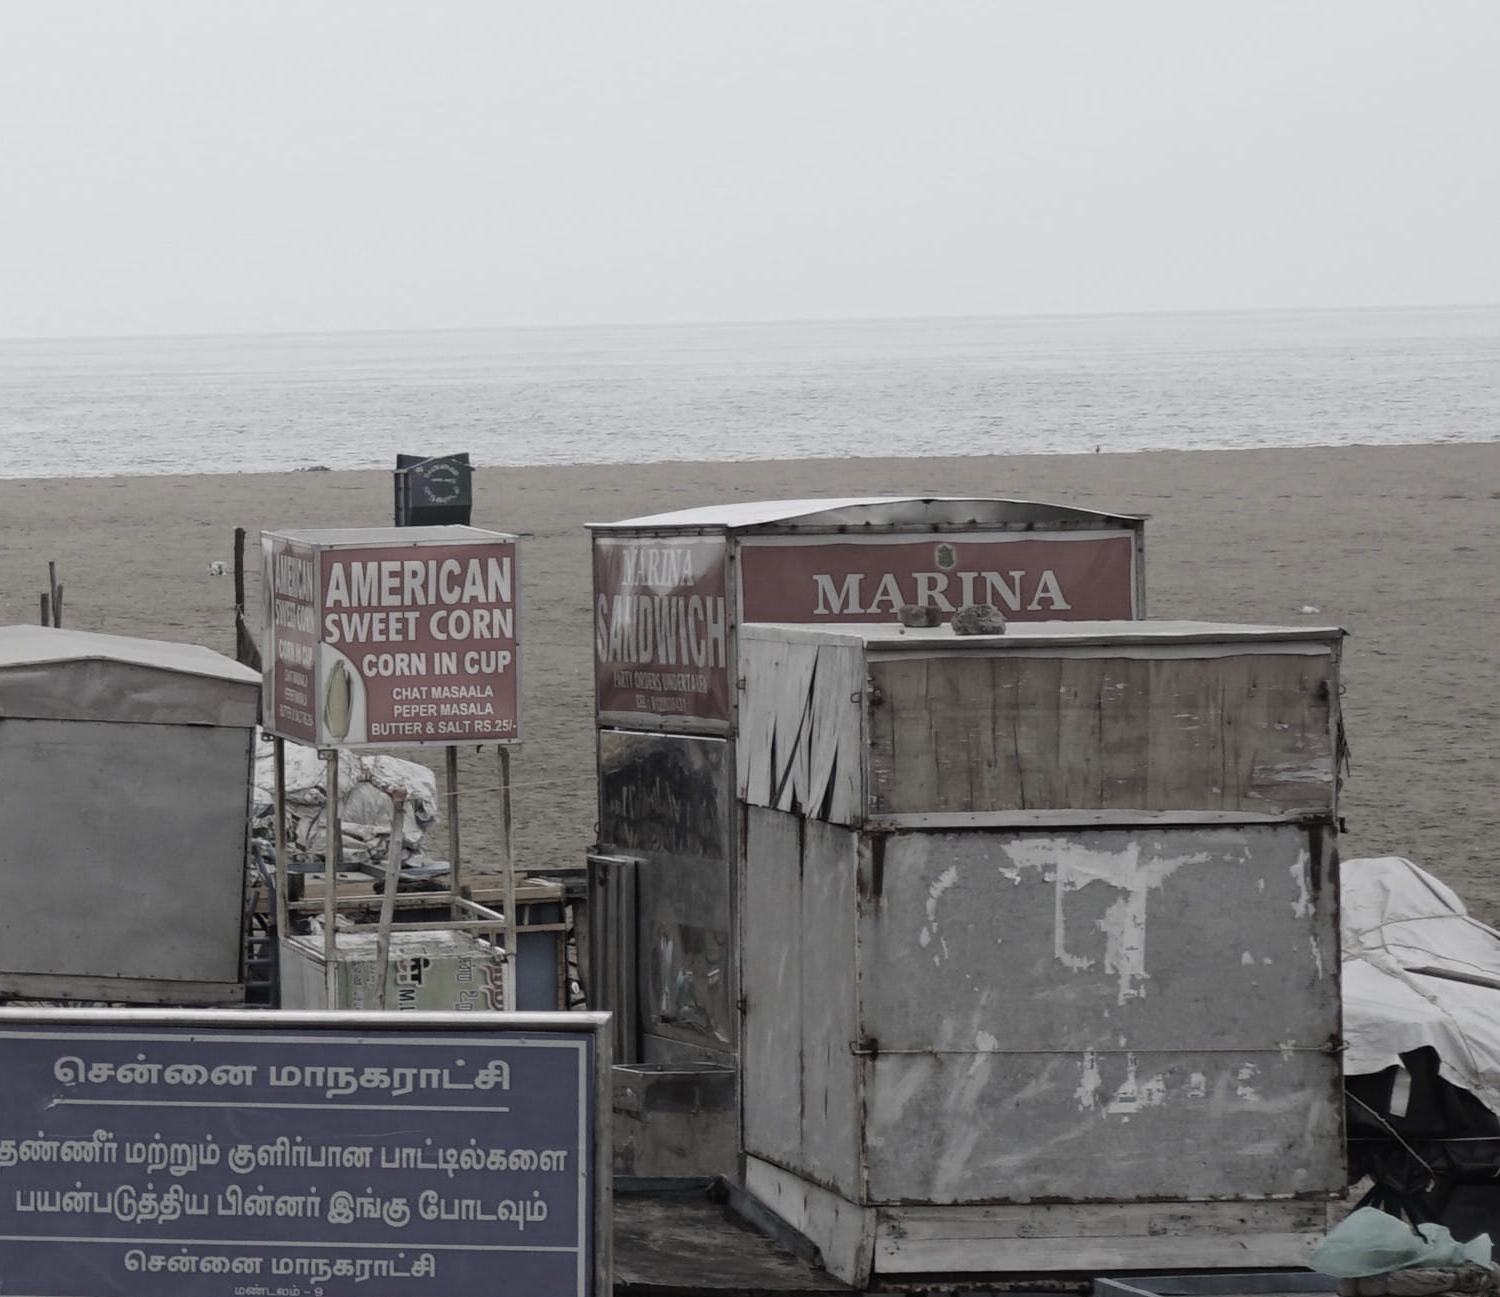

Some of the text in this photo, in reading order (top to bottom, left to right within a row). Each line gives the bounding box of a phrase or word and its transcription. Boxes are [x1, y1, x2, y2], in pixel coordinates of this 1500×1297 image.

[325, 557, 511, 608] AMERICAN
[812, 570, 1072, 615] MARINA
[324, 608, 513, 643] SWEET CORN
[597, 593, 725, 668] SANDWICH
[362, 651, 511, 677] CORN IN CUP
[393, 685, 494, 700] CHAT MASAALA
[393, 703, 494, 717] PEPER MASALA
[371, 722, 422, 735] BUTTER
[425, 722, 435, 734] &
[438, 720, 471, 734] SALT
[53, 1054, 511, 1098] சென்னை மாநகராட்சி
[125, 1133, 221, 1176] மற்றும்
[227, 1136, 373, 1177] குளிர்பான
[382, 1137, 568, 1178] பாட்டில்களை
[16, 1181, 548, 1230] பயன்படுத்திய பின்னர் இங்கு போடவும்
[124, 1246, 437, 1283] சென்னை மாநகராட்சி
[234, 1284, 324, 1297] மண்டலம் 9
